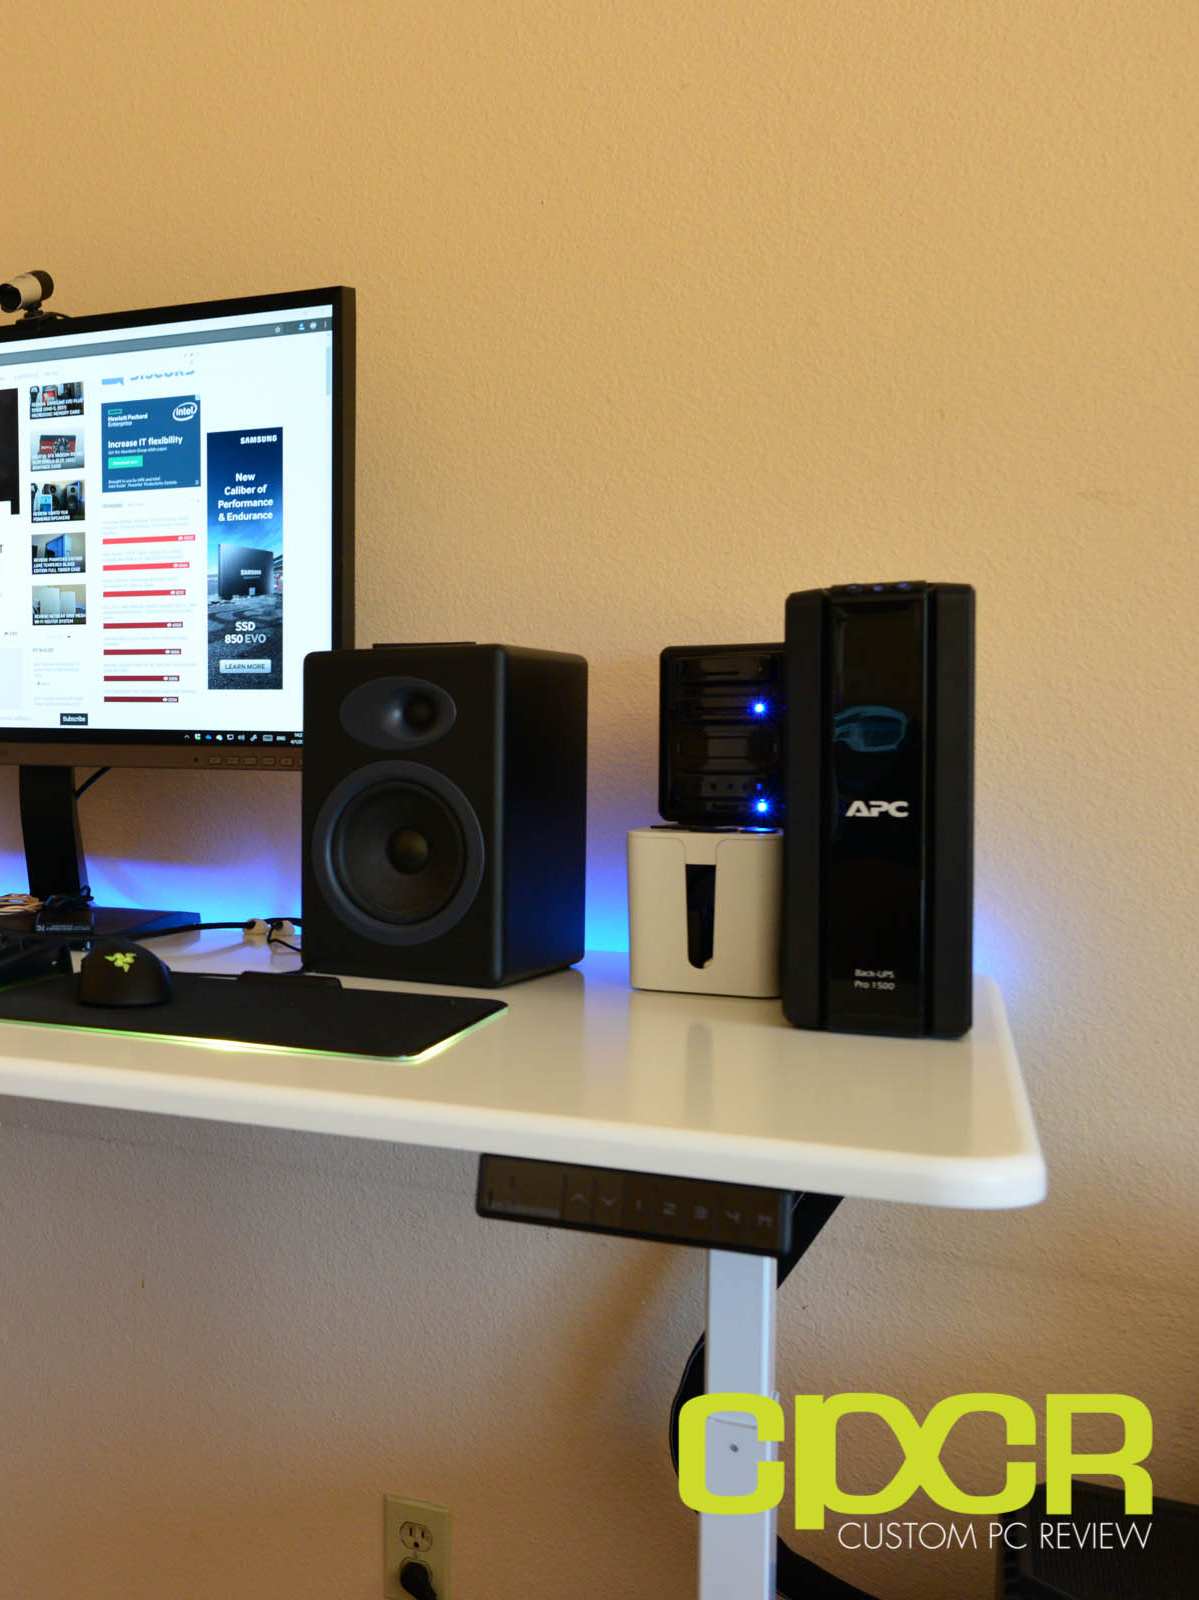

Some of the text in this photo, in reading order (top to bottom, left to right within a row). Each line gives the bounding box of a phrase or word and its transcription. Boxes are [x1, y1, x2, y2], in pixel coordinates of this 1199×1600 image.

[108, 435, 183, 449] Increase IT flexibility
[240, 435, 277, 445] SAMSUNG
[235, 473, 256, 482] New
[224, 484, 268, 495] Caliber of
[218, 499, 273, 509] Performance
[218, 512, 273, 522] & Endurance
[235, 621, 256, 631] SSD
[224, 634, 266, 644] 850 EVO
[845, 800, 909, 818] APC
